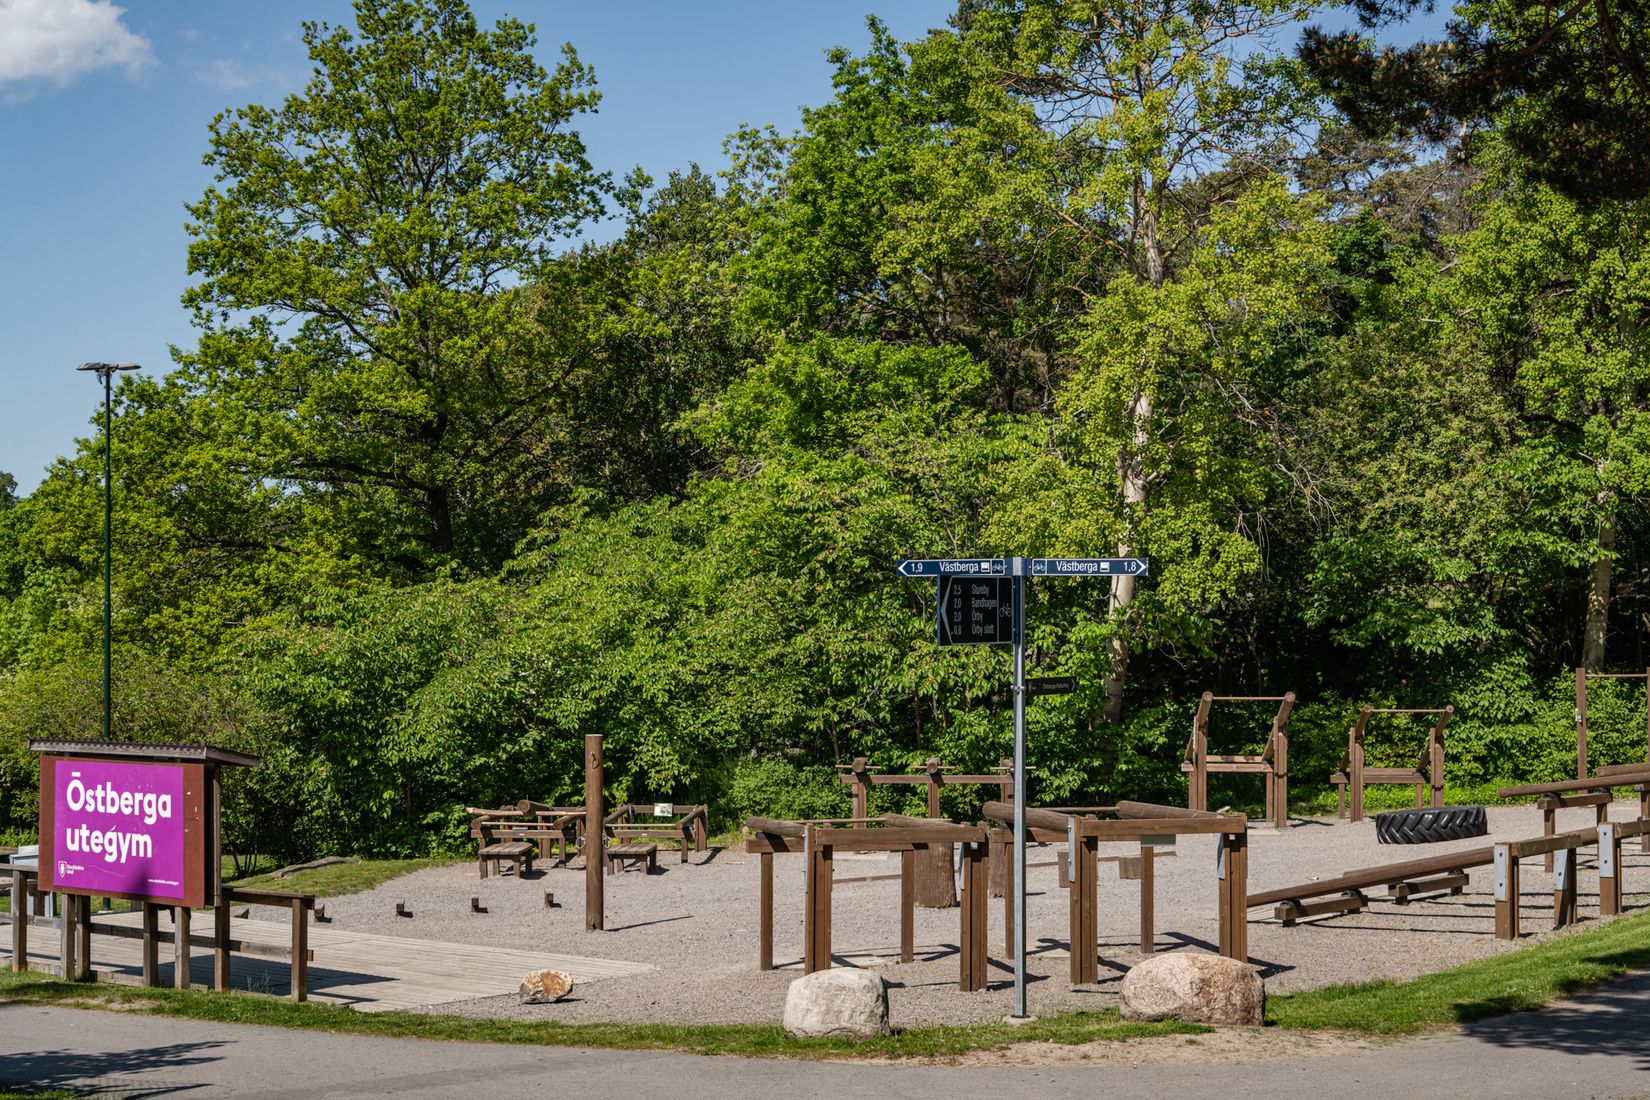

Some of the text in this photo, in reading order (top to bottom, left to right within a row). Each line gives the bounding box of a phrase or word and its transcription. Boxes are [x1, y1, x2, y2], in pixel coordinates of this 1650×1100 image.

[911, 562, 979, 573] 1,9 Västberga
[1056, 561, 1137, 573] Västberga 1,8
[953, 585, 962, 595] 2,5
[953, 598, 962, 609] 2,0
